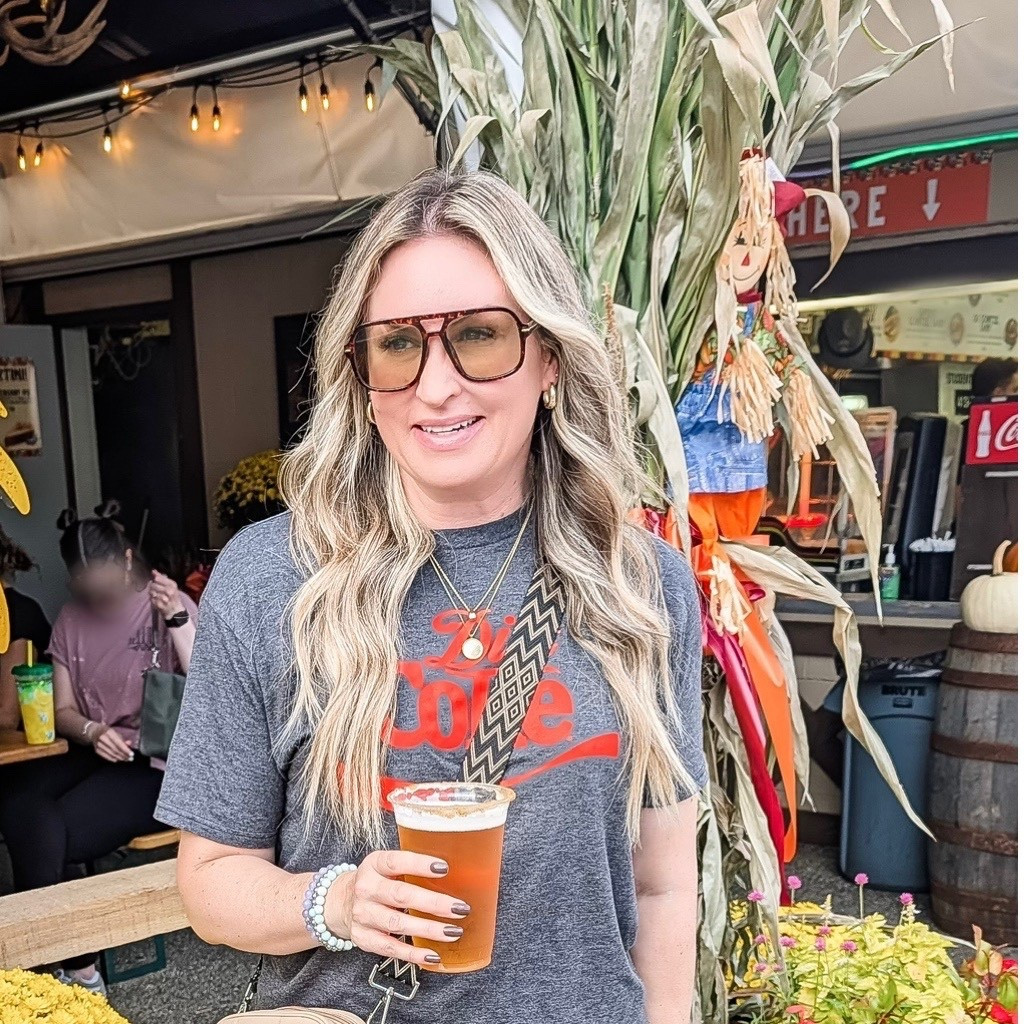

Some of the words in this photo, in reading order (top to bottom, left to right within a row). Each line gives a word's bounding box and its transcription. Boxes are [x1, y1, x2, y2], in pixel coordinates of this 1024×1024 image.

[787, 185, 888, 238] HERE
[424, 608, 557, 672] Di
[881, 684, 926, 697] BRUTE
